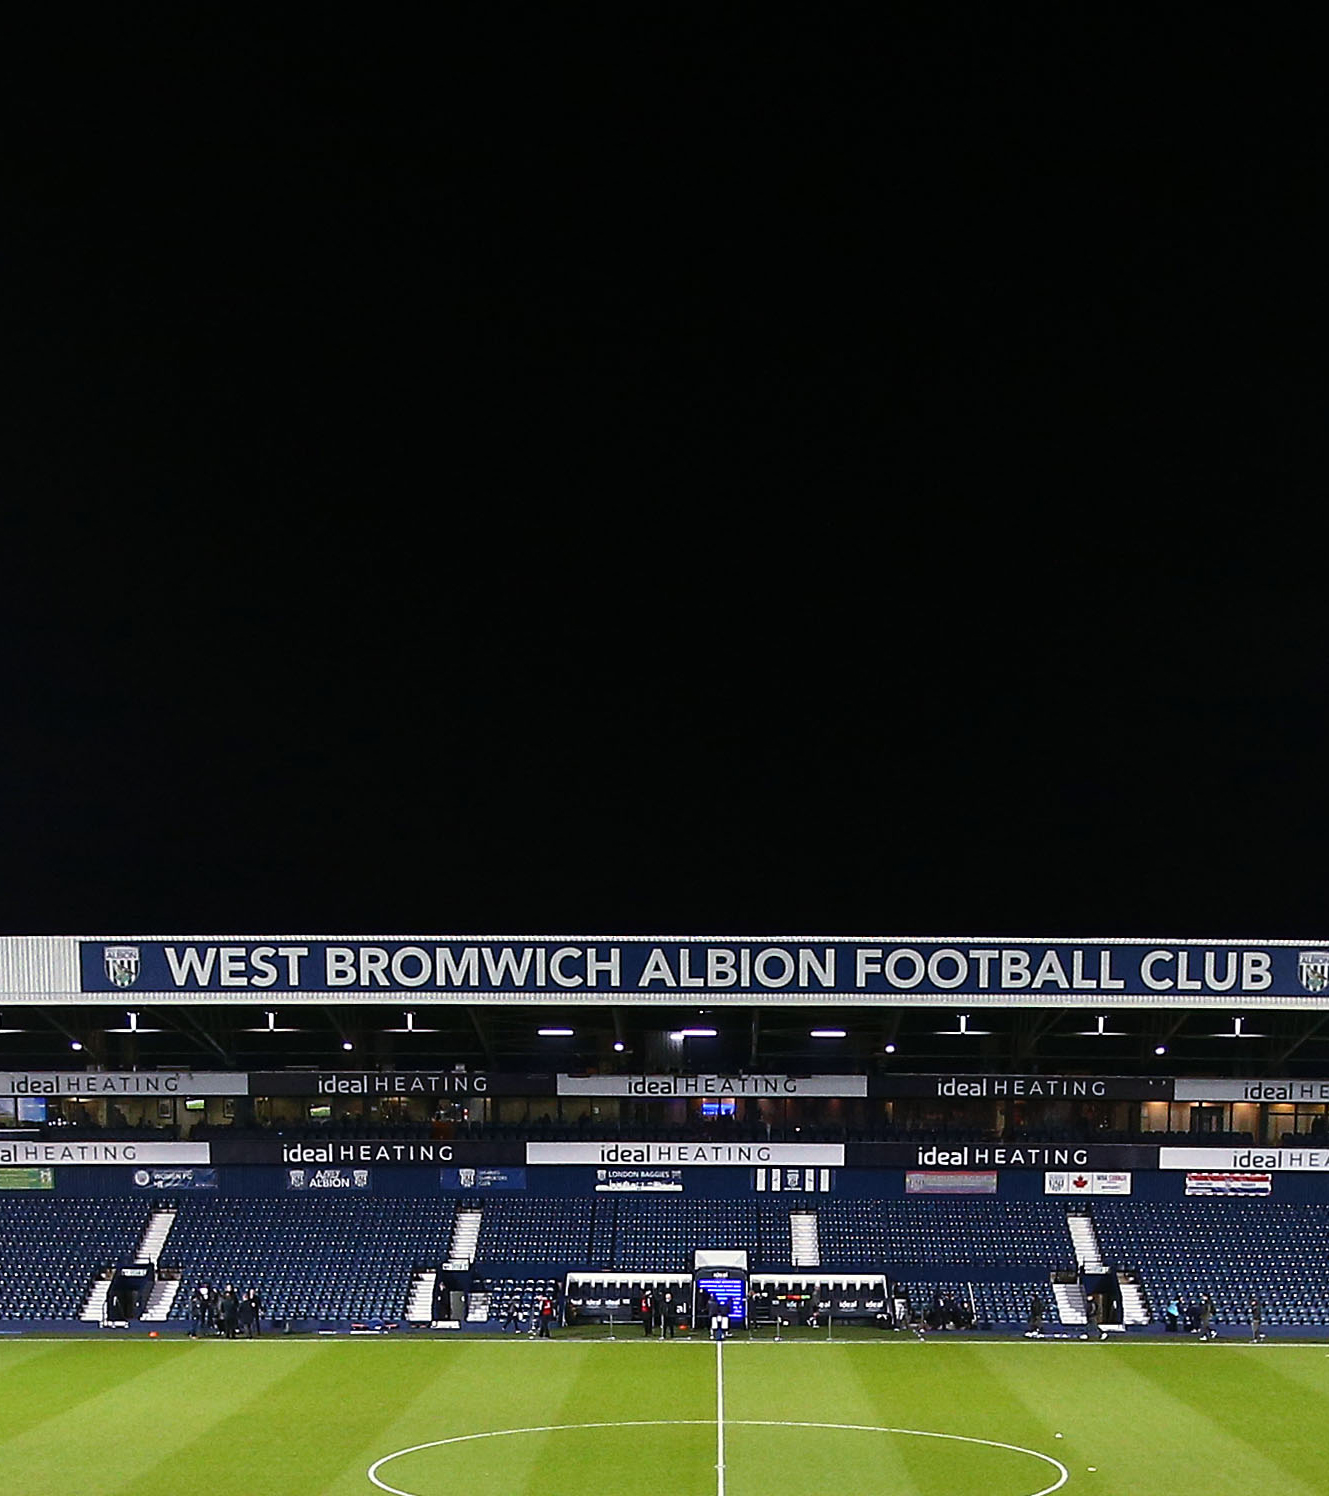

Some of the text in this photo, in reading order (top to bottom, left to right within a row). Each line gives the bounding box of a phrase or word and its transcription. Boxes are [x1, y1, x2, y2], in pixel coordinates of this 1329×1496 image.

[165, 947, 1271, 990] WEST BROMWICH ALBION FOOTBALL CLUB
[12, 1076, 180, 1093] ideal HEATING
[319, 1075, 486, 1093] ideal HEATING
[628, 1075, 797, 1094] ideal HEATING
[938, 1078, 1104, 1096] ideal HEATING
[1245, 1082, 1293, 1099] ideal
[25, 1146, 135, 1160] HEATING
[284, 1144, 452, 1162] ideal HEATING
[601, 1145, 770, 1162] ideal HEATING
[919, 1147, 1086, 1165] ideal HEATING
[1234, 1150, 1282, 1168] ideal
[309, 1178, 350, 1188] ALBION
